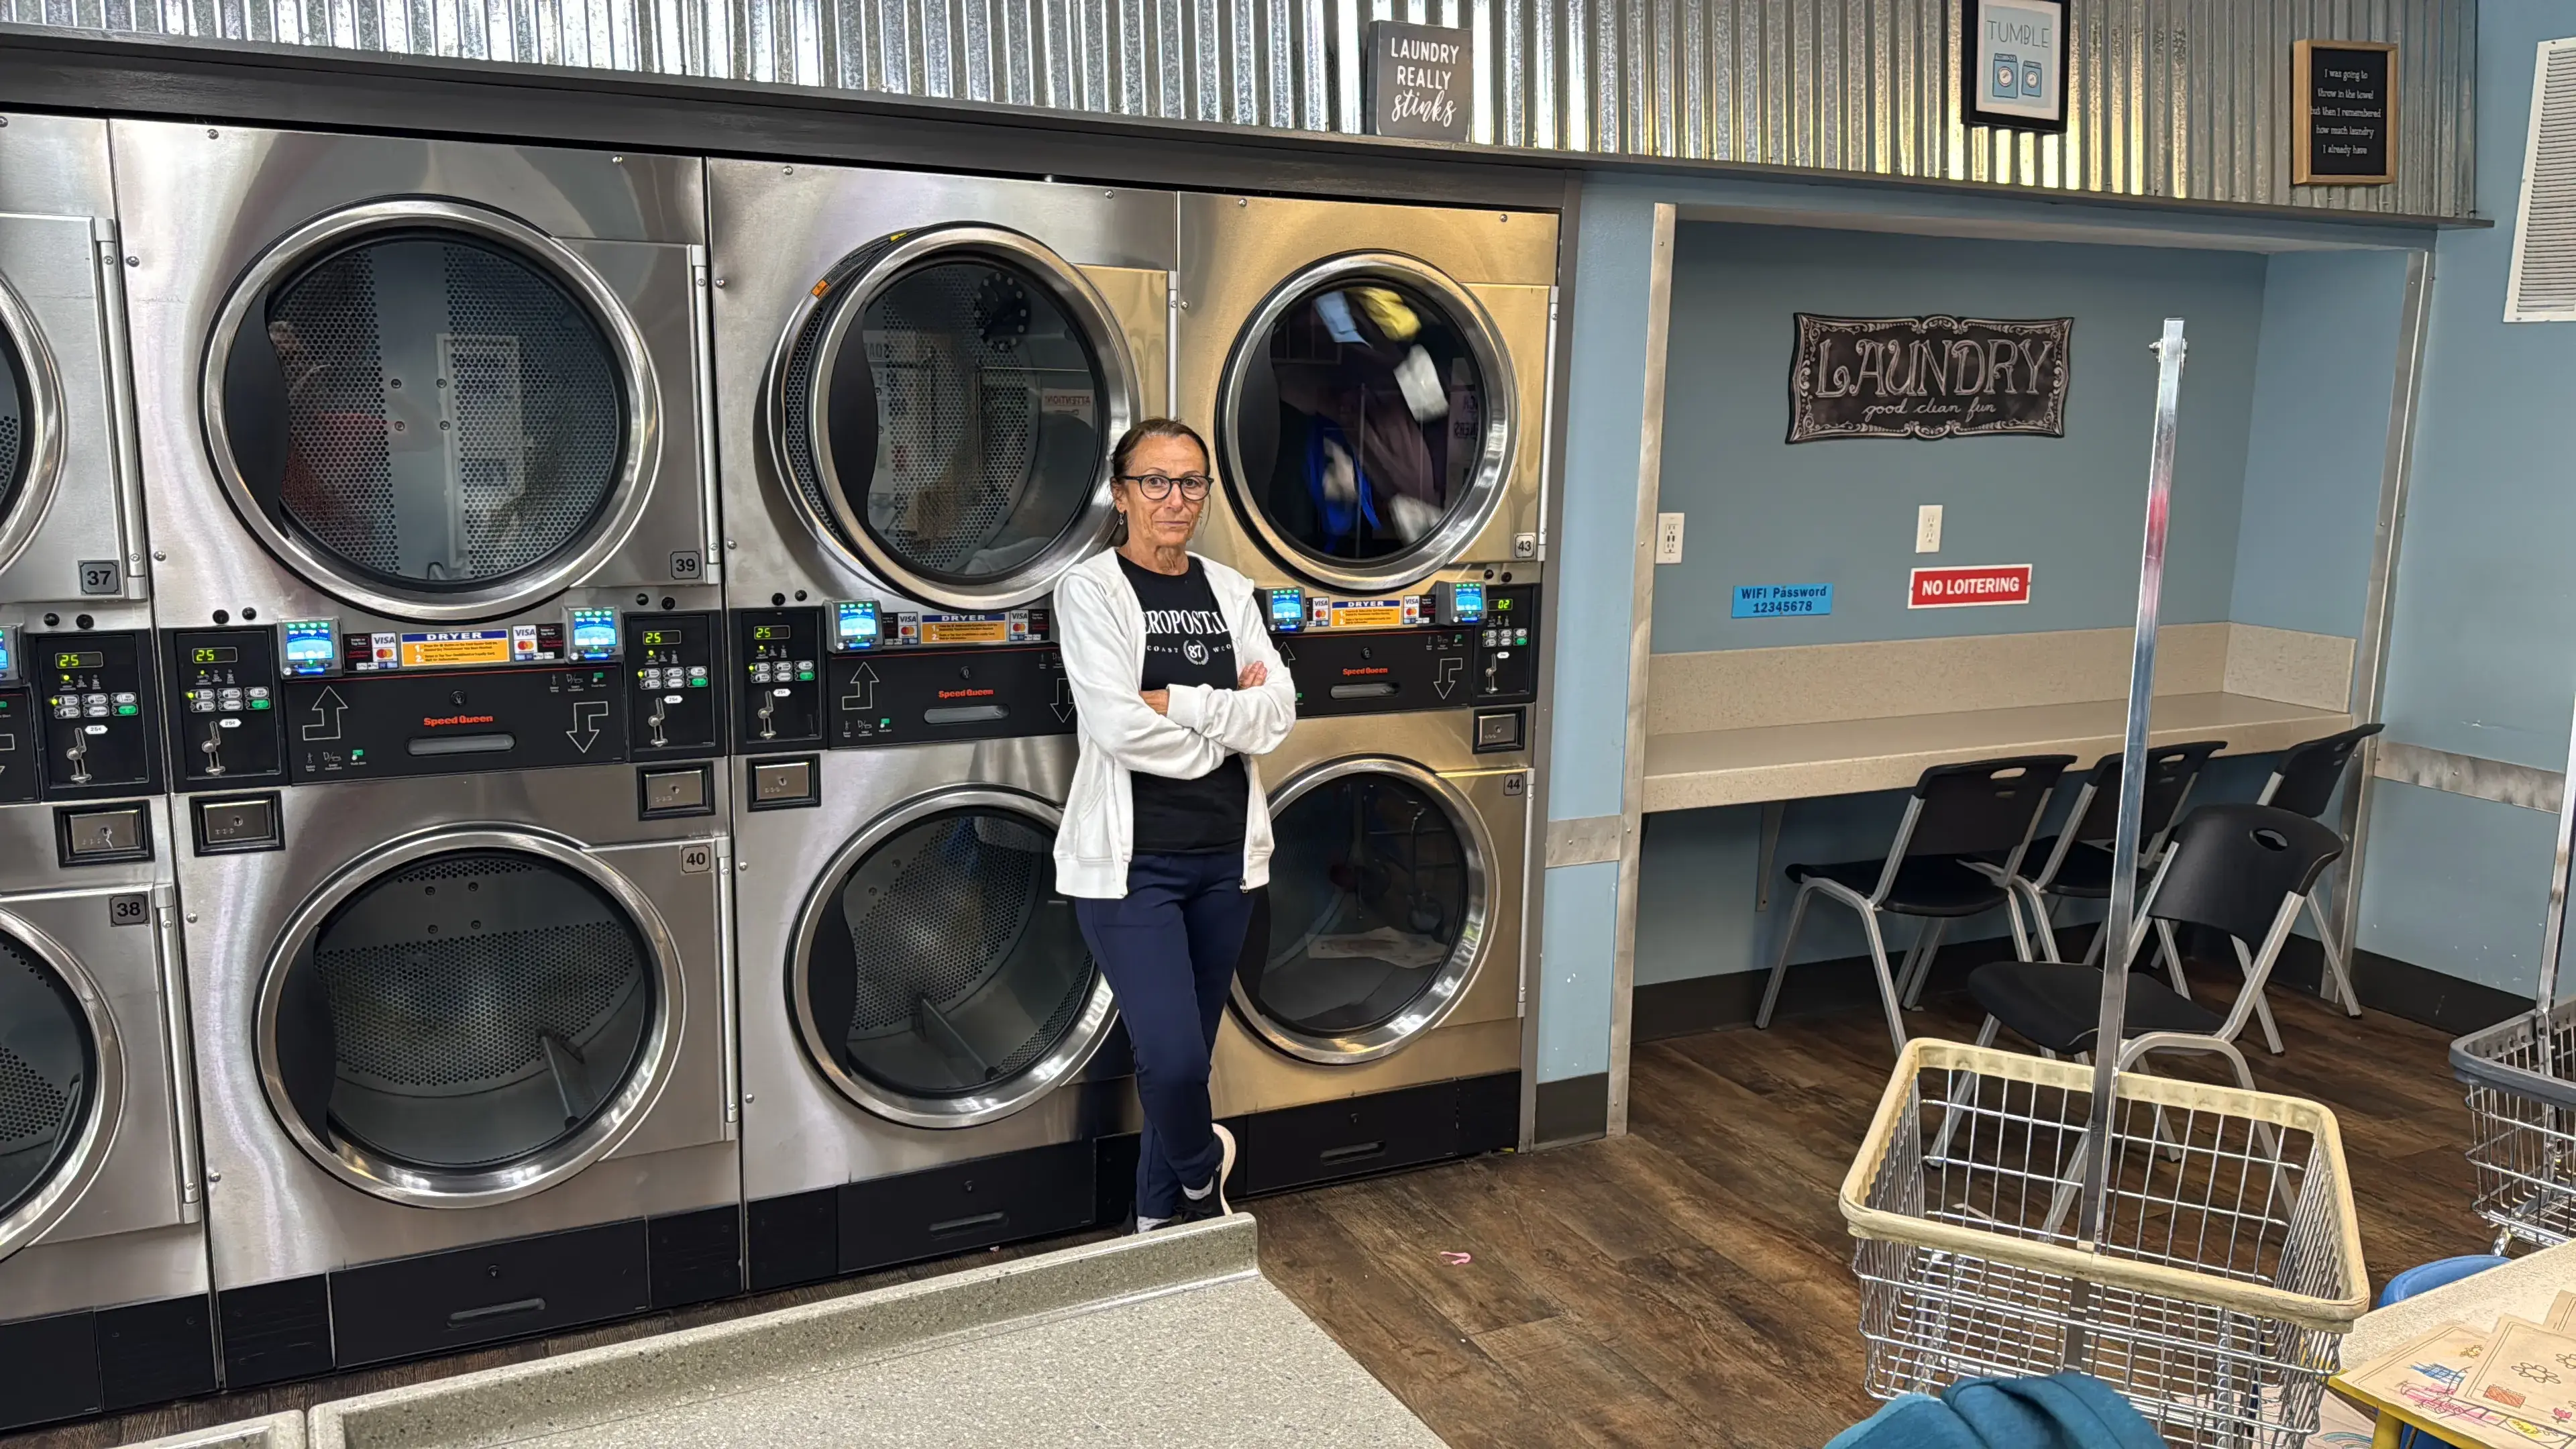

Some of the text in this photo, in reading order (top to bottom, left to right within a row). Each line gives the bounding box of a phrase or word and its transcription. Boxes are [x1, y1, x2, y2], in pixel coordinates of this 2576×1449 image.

[1986, 19, 2050, 48] TUMBLE
[1391, 37, 1459, 64] LAUNDRY
[1397, 65, 1452, 91] REALLY
[2324, 68, 2328, 78] I
[2343, 71, 2360, 82] going
[2361, 70, 2368, 79] to
[2318, 88, 2374, 99] throw in the towel
[1391, 89, 1457, 127] stinks
[2322, 106, 2336, 116] then
[2337, 107, 2341, 117] I
[2341, 108, 2381, 118] remembered
[2316, 124, 2375, 140] how much laundry
[2322, 144, 2326, 154] I
[2328, 144, 2352, 157] already
[1815, 339, 2053, 398] LAUNDRY
[1862, 397, 1996, 423] good clean fun
[1517, 541, 1531, 551] 43
[676, 558, 696, 572] 39
[87, 570, 111, 586] 37
[1922, 577, 2020, 596] NO LOITERING
[1741, 586, 1827, 600] WIFI Password
[1497, 599, 1510, 610] 02
[1752, 600, 1813, 614] 12345678
[941, 614, 986, 623] DRYER
[427, 632, 482, 641] DRYER
[515, 629, 535, 637] VISA
[645, 633, 661, 643] 25
[756, 628, 770, 638] 25
[374, 637, 395, 645] VISA
[415, 644, 424, 653] 1.
[1146, 645, 1179, 653] COAST
[1188, 645, 1202, 659] 87
[60, 655, 78, 666] 25
[197, 650, 214, 661] 25
[415, 655, 425, 663] 2.
[1342, 668, 1364, 676] Speed
[424, 715, 493, 727] Speed Queen
[1507, 779, 1520, 789] 44
[686, 853, 706, 865] 40
[116, 902, 141, 916] 38
